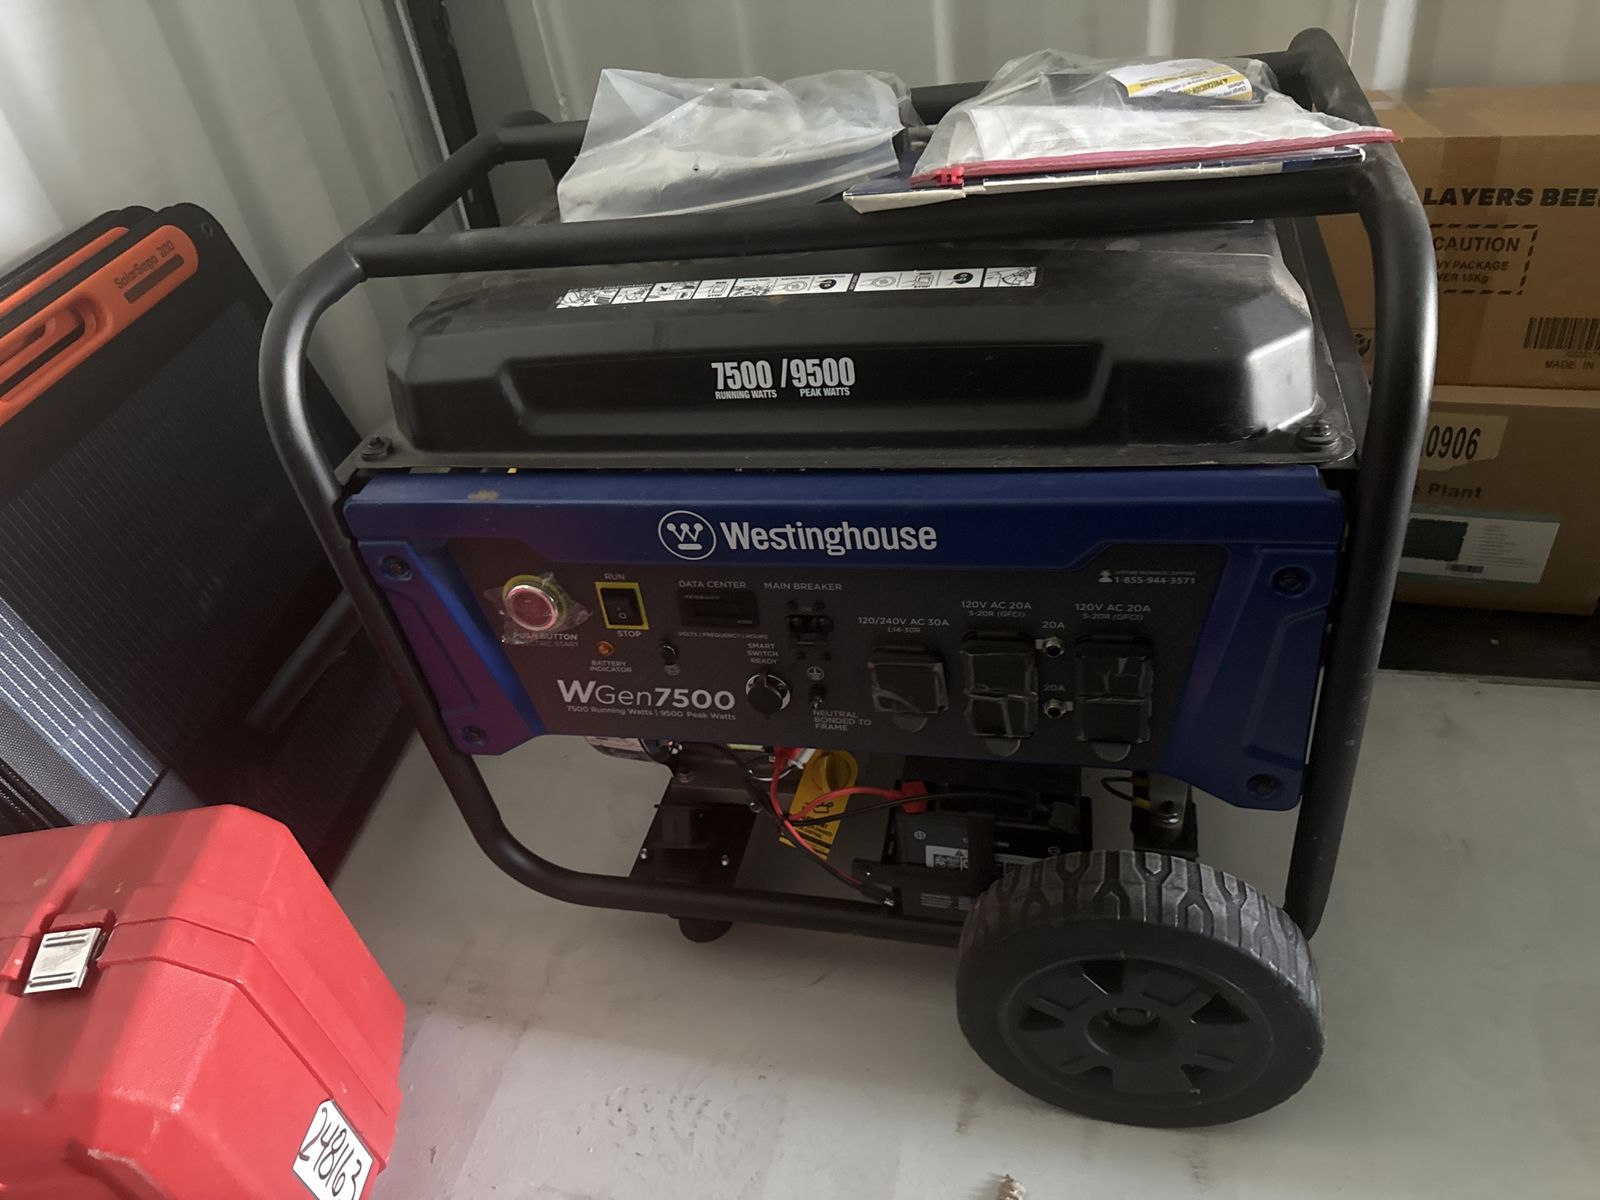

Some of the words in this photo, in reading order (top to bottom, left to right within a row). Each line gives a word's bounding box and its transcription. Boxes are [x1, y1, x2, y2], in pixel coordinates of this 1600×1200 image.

[1424, 188, 1533, 206] LAYERS
[1540, 188, 1600, 207] BEE
[157, 240, 175, 257] 200
[1434, 237, 1520, 251] CAUTION
[1452, 260, 1510, 270] PACKAGE
[1437, 272, 1459, 282] VER
[1461, 273, 1489, 285] 15Kg
[1545, 360, 1576, 370] MADE
[1582, 361, 1595, 371] IN
[711, 360, 773, 390] 7500
[715, 390, 750, 400] RUNNING
[751, 389, 777, 398] WATTS
[800, 388, 822, 398] PEAK
[823, 387, 850, 396] WATTS
[1420, 425, 1481, 460] 0906
[1428, 483, 1483, 499] Plant
[720, 521, 938, 556] Westinghouse
[604, 572, 626, 582] RUN
[1114, 576, 1196, 586] 1-855-944-3571
[678, 580, 705, 589] DATA
[706, 580, 747, 590] CENTER
[764, 582, 791, 590] MAIN
[794, 582, 842, 592] BREAKER
[960, 601, 989, 609] 120V
[990, 602, 1007, 610] AC
[1008, 602, 1032, 610] 20A
[1074, 603, 1104, 612] 120V
[1107, 604, 1124, 612] AC
[1127, 604, 1151, 613] 20A
[995, 610, 1026, 619] (GFCI)
[1111, 613, 1144, 622] (GFCI)
[858, 617, 906, 626] 120/240V
[908, 618, 926, 626] AC
[927, 618, 950, 627] 30A
[1042, 621, 1065, 630] 20A
[540, 633, 578, 641] BUTTON
[616, 630, 642, 639] STOP
[748, 642, 776, 650] SMART
[747, 650, 779, 658] SWITCH
[589, 666, 632, 674] INDICATOR
[1043, 684, 1066, 693] 20A
[556, 679, 736, 710] WGen7500
[568, 705, 590, 713] 7500
[592, 706, 626, 716] Running
[628, 708, 653, 716] Watts
[660, 710, 684, 718] 9500
[687, 711, 707, 719] Peak
[710, 712, 736, 721] Watts
[813, 710, 859, 719] NEUTRAL
[814, 717, 855, 726] BONDED
[858, 718, 872, 726] TO
[815, 724, 848, 732] FRAME
